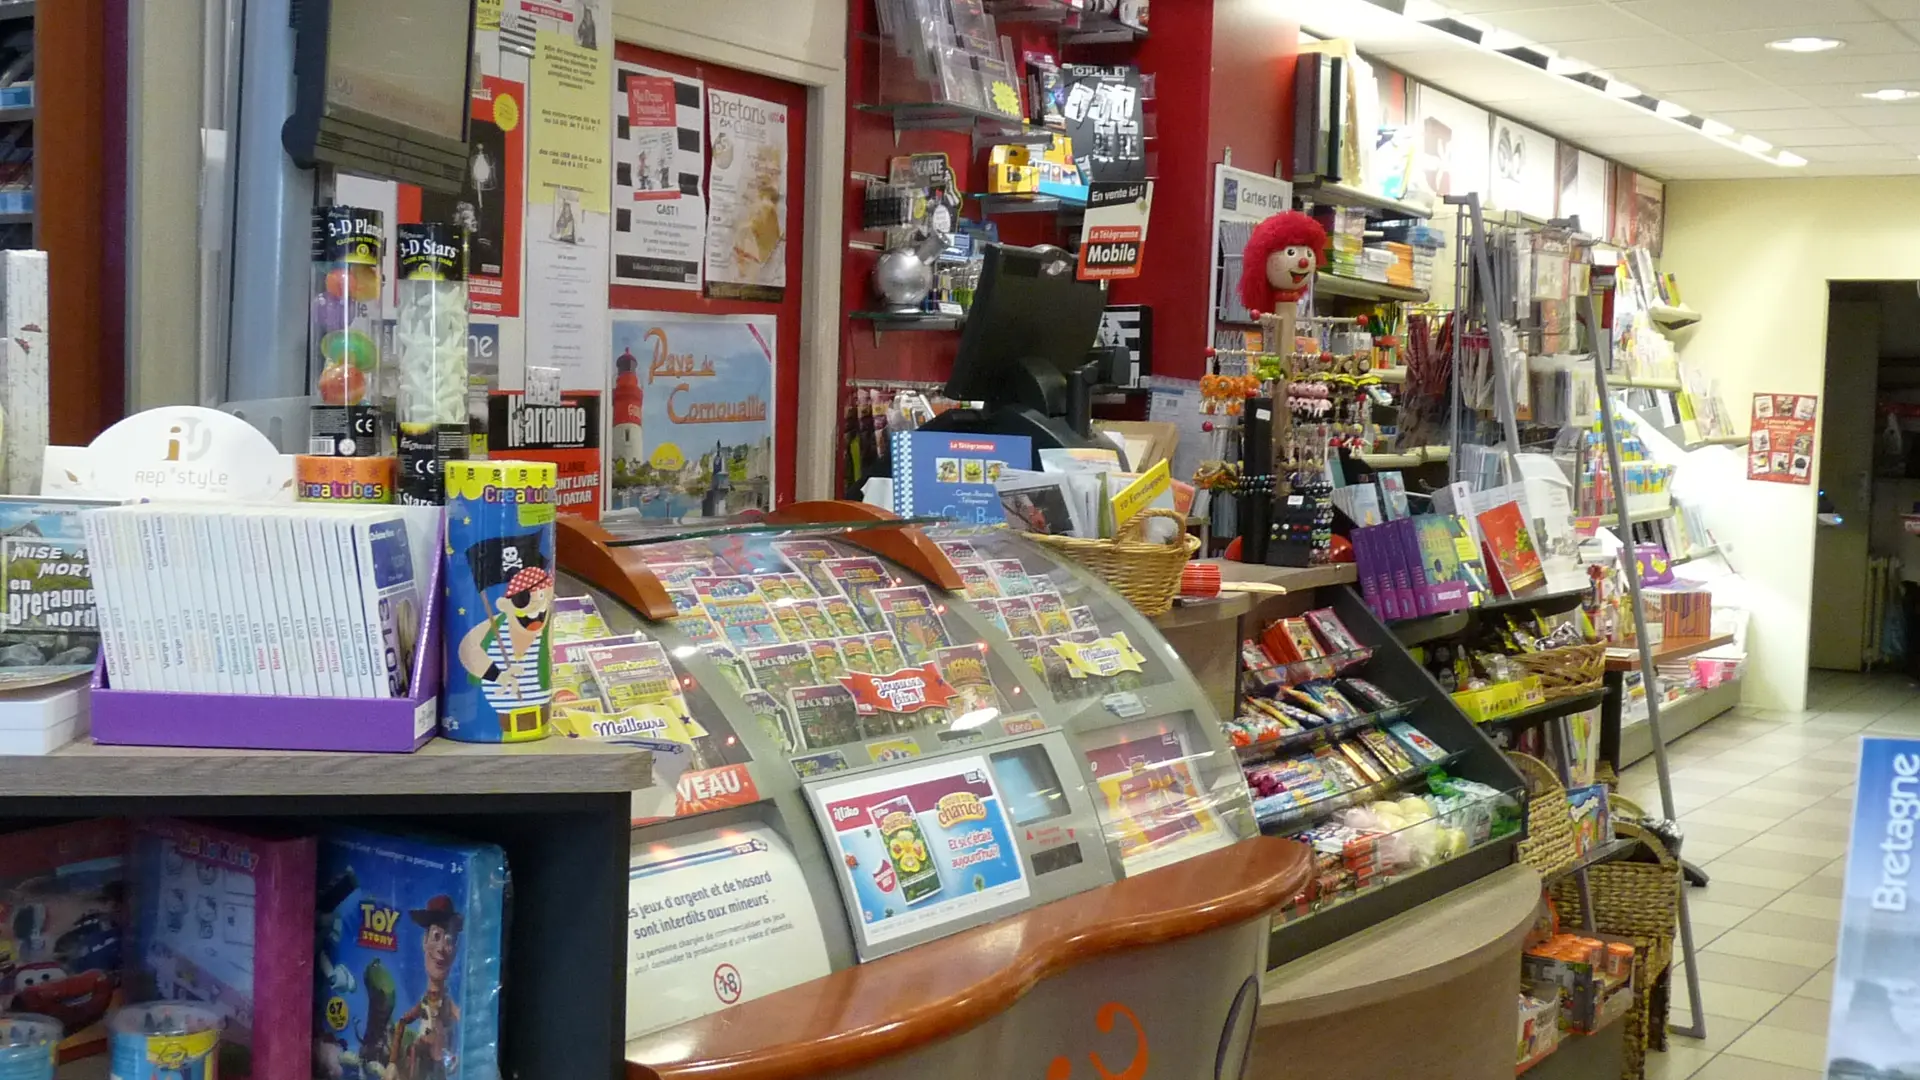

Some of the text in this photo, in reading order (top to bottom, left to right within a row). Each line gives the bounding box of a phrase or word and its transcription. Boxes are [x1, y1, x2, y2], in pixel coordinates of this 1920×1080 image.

[710, 92, 766, 124] Bretons
[1092, 191, 1103, 202] En
[1105, 189, 1127, 200] vente
[1129, 186, 1138, 197] ici
[1241, 188, 1284, 209] Cartes IGN
[328, 219, 352, 238] 3-D
[1090, 228, 1139, 240] Le Télégramme
[423, 240, 456, 259] Stars
[1087, 243, 1136, 263] Mobile
[644, 327, 714, 385] Pays de
[667, 383, 767, 424] Cornouaille
[507, 394, 587, 447] Marianne
[958, 442, 994, 451] Télégramme
[299, 480, 384, 500] Creatubes
[573, 472, 599, 489] LIVRÉ
[563, 491, 592, 507] QATAR
[11, 546, 63, 563] MISE
[37, 562, 92, 580] MORT
[9, 579, 32, 591] en
[9, 589, 96, 626] Bretagne
[594, 716, 667, 737] Meilleurs
[1009, 721, 1032, 733] Keno
[677, 769, 742, 802] VEAU
[834, 806, 860, 822] illiko
[938, 801, 985, 826] chance
[1872, 753, 1920, 912] Bretagne
[451, 862, 464, 875] 3+
[640, 898, 664, 921] jeux
[666, 887, 710, 910] d'argent
[711, 885, 722, 896] et
[724, 881, 737, 894] de
[738, 871, 772, 891] hasard
[361, 903, 400, 933] TOY
[634, 922, 660, 939] sont
[660, 908, 707, 932] interdits
[708, 904, 727, 920] aux
[362, 930, 394, 946] STORY
[329, 1001, 343, 1016] 67
